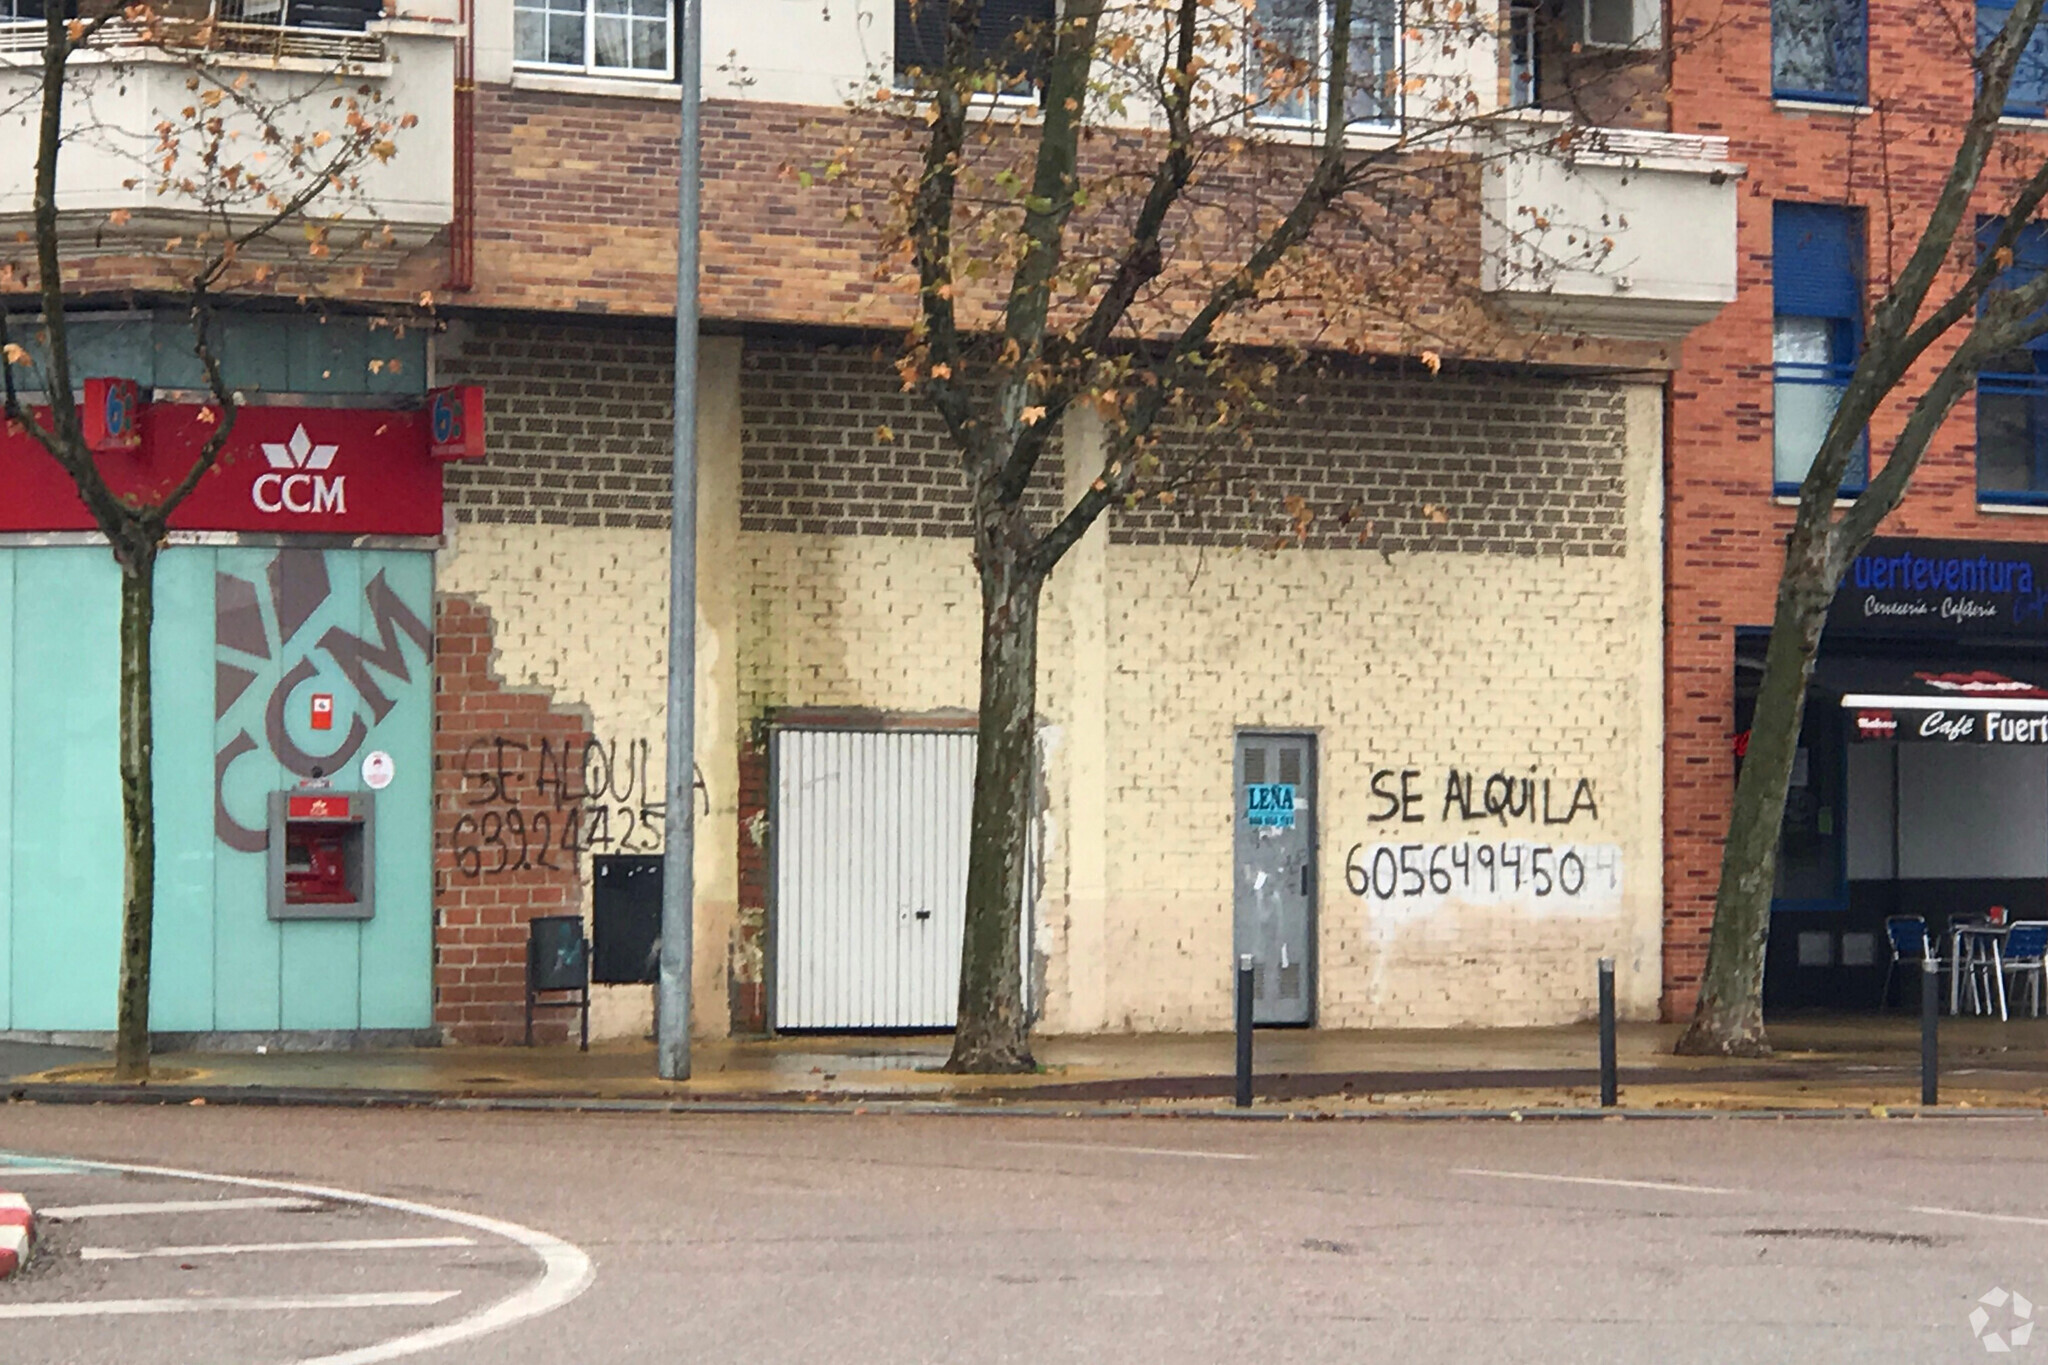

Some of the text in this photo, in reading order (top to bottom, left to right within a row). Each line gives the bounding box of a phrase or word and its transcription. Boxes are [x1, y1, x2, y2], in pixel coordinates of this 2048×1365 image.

[252, 473, 347, 514] CCM
[1839, 551, 2034, 593] uerteventura
[1367, 769, 1425, 823] SE
